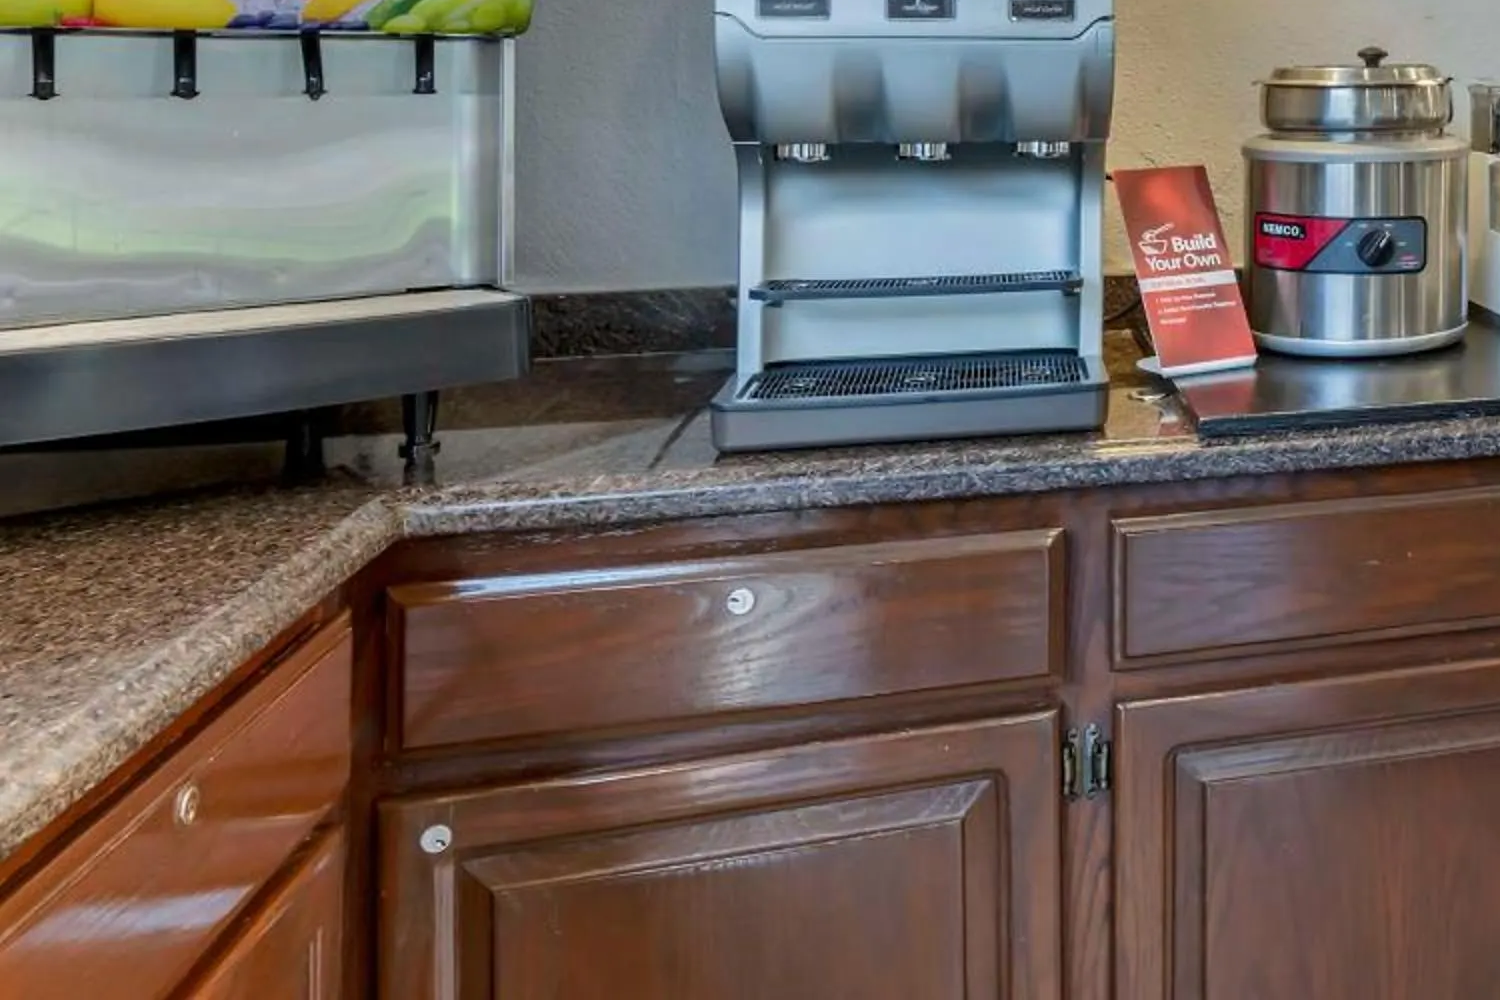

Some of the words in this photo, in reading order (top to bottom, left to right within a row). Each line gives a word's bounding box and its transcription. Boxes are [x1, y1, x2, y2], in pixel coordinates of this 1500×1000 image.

[1262, 222, 1300, 237] NEMCO
[1170, 232, 1217, 253] Build
[1145, 255, 1181, 272] Your
[1183, 252, 1221, 269] Own
